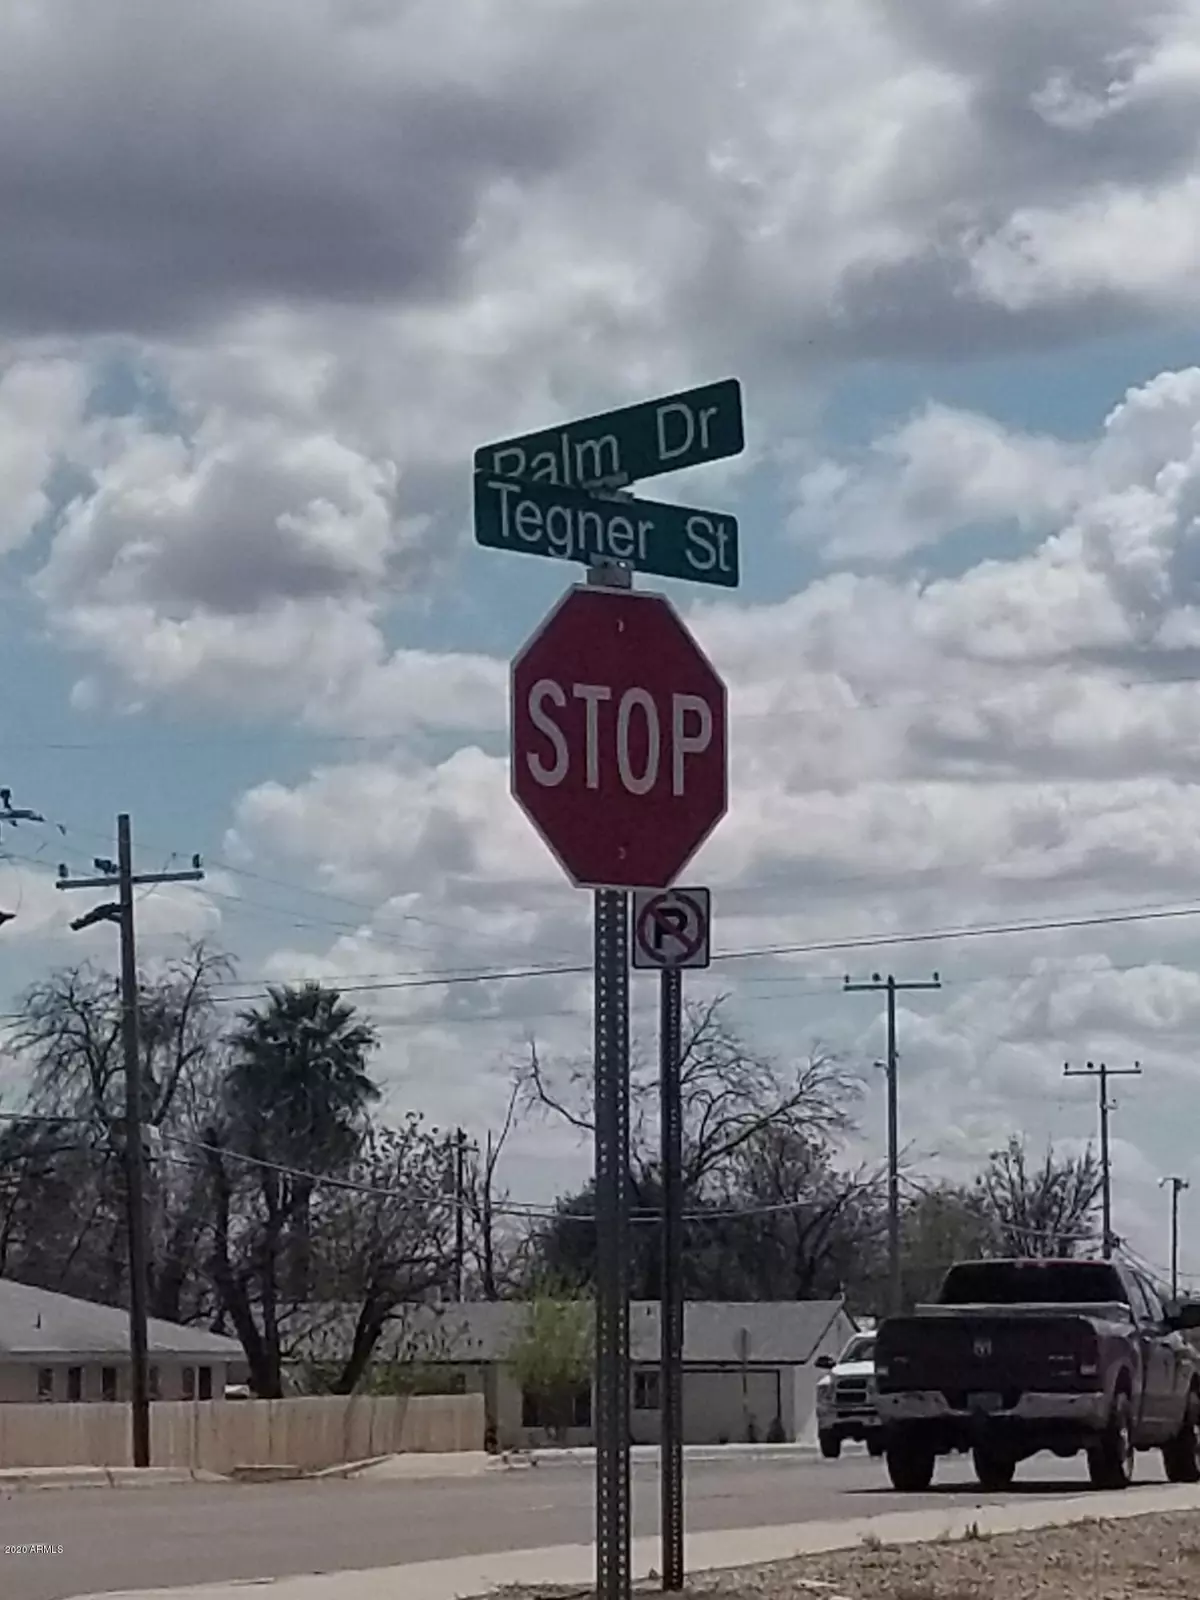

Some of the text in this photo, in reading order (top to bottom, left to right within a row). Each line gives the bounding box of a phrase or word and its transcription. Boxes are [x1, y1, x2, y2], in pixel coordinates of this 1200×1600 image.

[493, 403, 718, 488] Palm Dr
[487, 480, 732, 572] Tegner St
[526, 679, 713, 796] STOP
[655, 907, 689, 949] P
